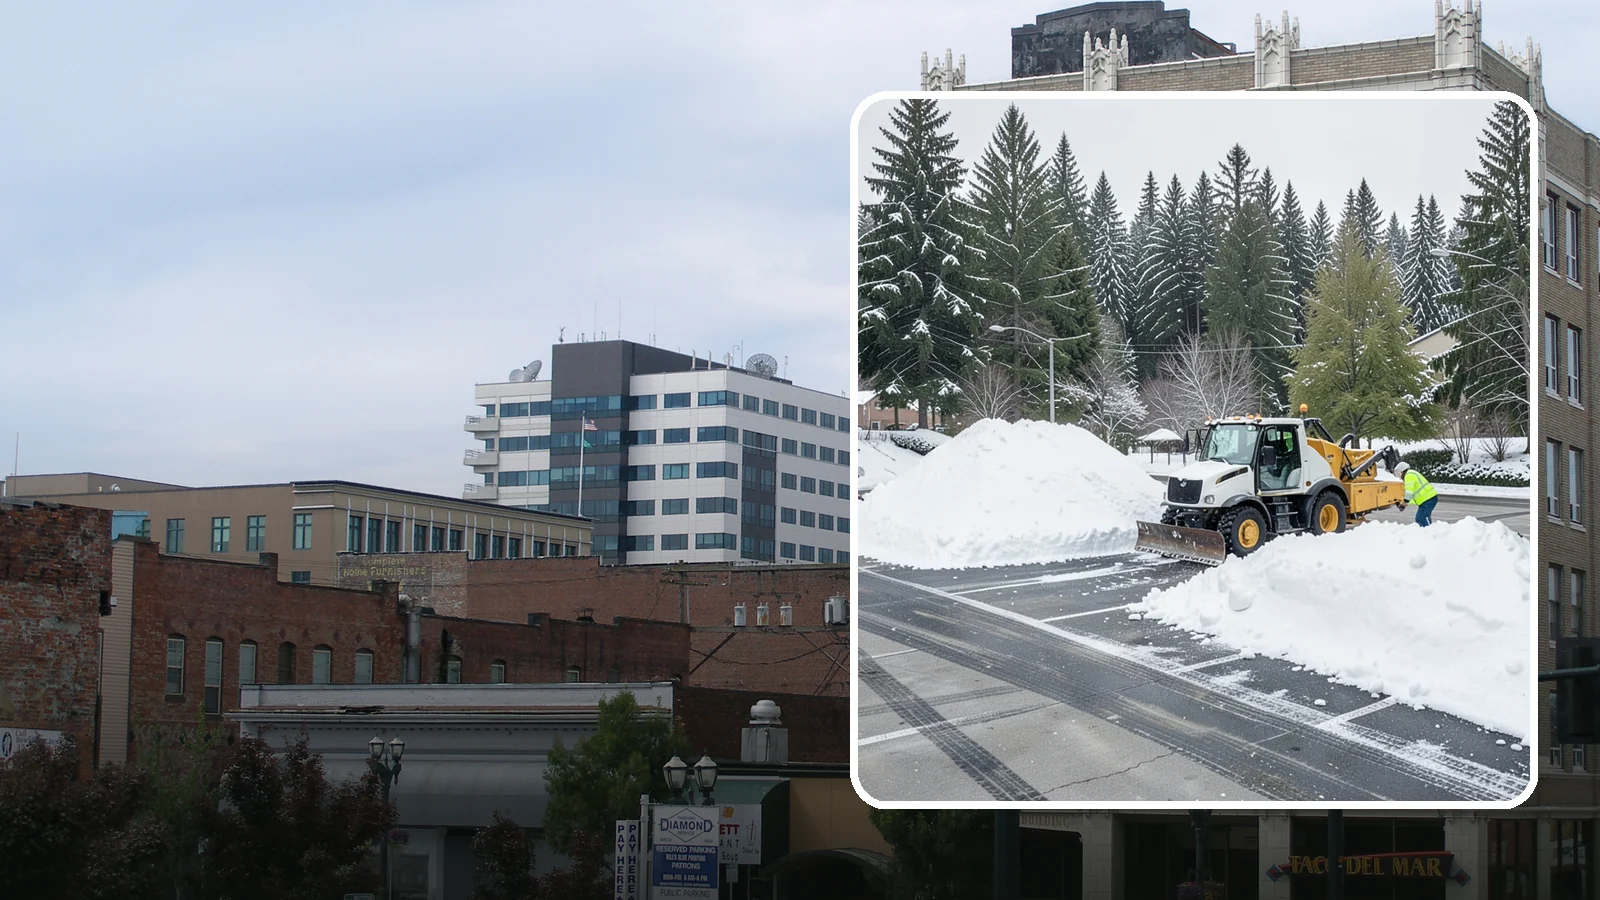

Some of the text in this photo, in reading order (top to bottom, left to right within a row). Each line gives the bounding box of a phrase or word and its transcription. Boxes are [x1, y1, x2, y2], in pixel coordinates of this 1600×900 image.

[370, 566, 427, 576] Furnishers
[660, 818, 713, 832] DIAMOND
[1022, 815, 1069, 828] BUILDING
[689, 846, 716, 854] PARKING
[721, 852, 739, 861] Soup
[616, 824, 625, 893] PAY HERE
[627, 824, 637, 893] PAY HERE
[1289, 855, 1442, 877] TAC DEL MAR
[660, 888, 710, 898] PUBLIC PARKING
